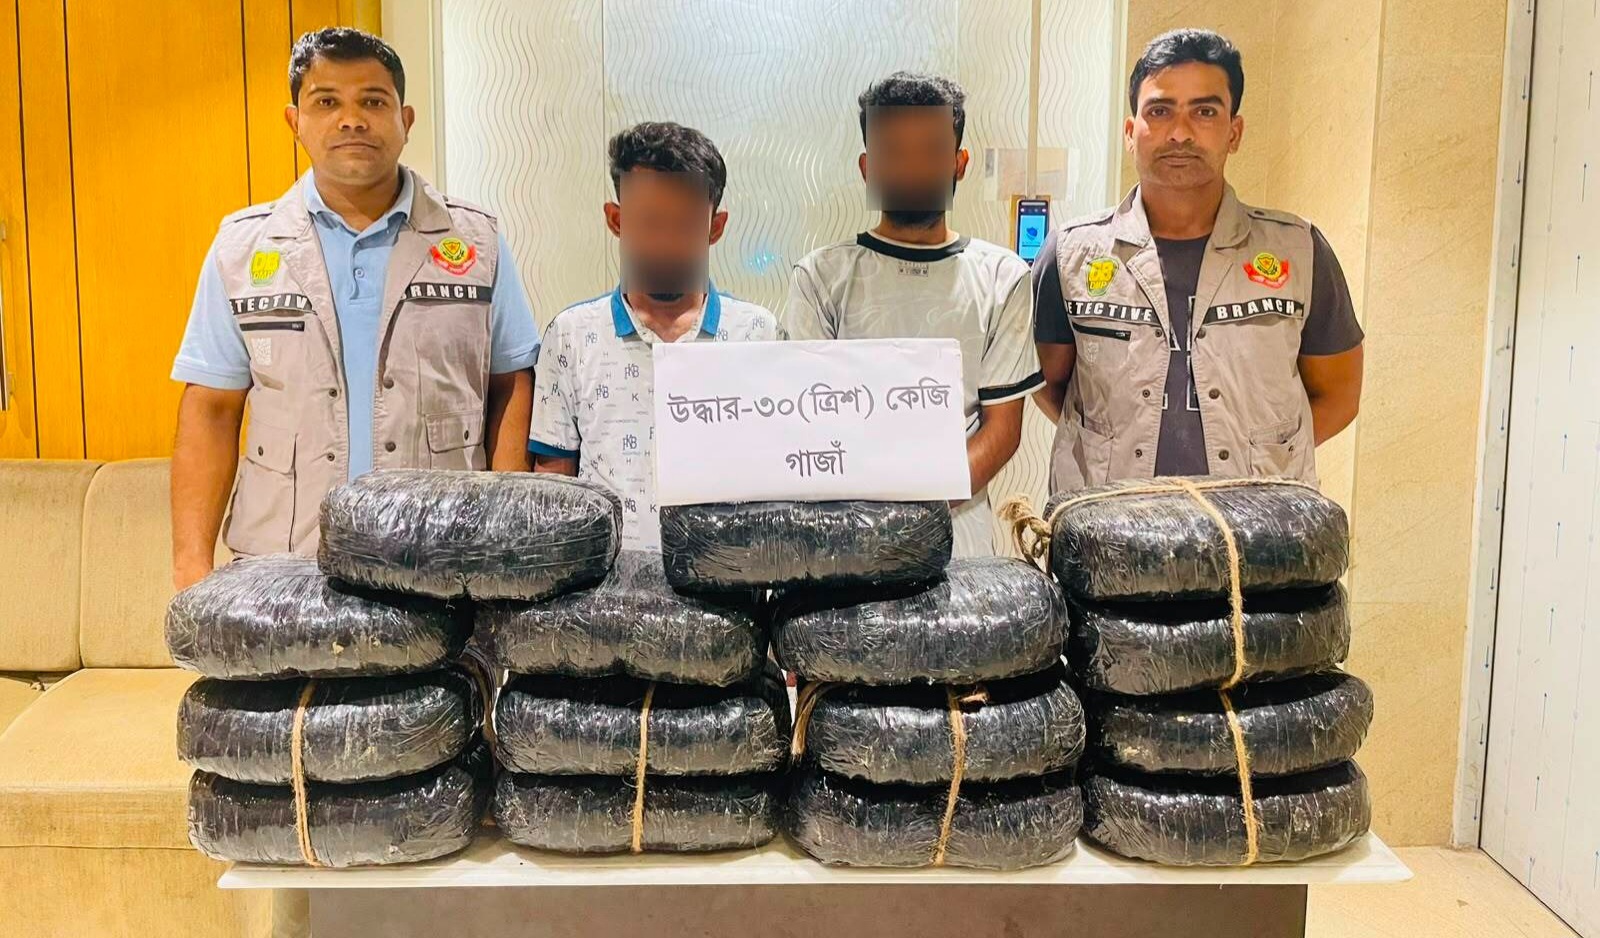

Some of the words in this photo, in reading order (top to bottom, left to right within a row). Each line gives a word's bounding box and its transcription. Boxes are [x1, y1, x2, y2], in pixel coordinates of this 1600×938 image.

[1065, 300, 1153, 322] ETECTIVE
[1215, 298, 1296, 320] BRANCH
[666, 382, 875, 424] উদ্ধার-৩০(ত্রিশ)
[885, 376, 952, 411] কেজি
